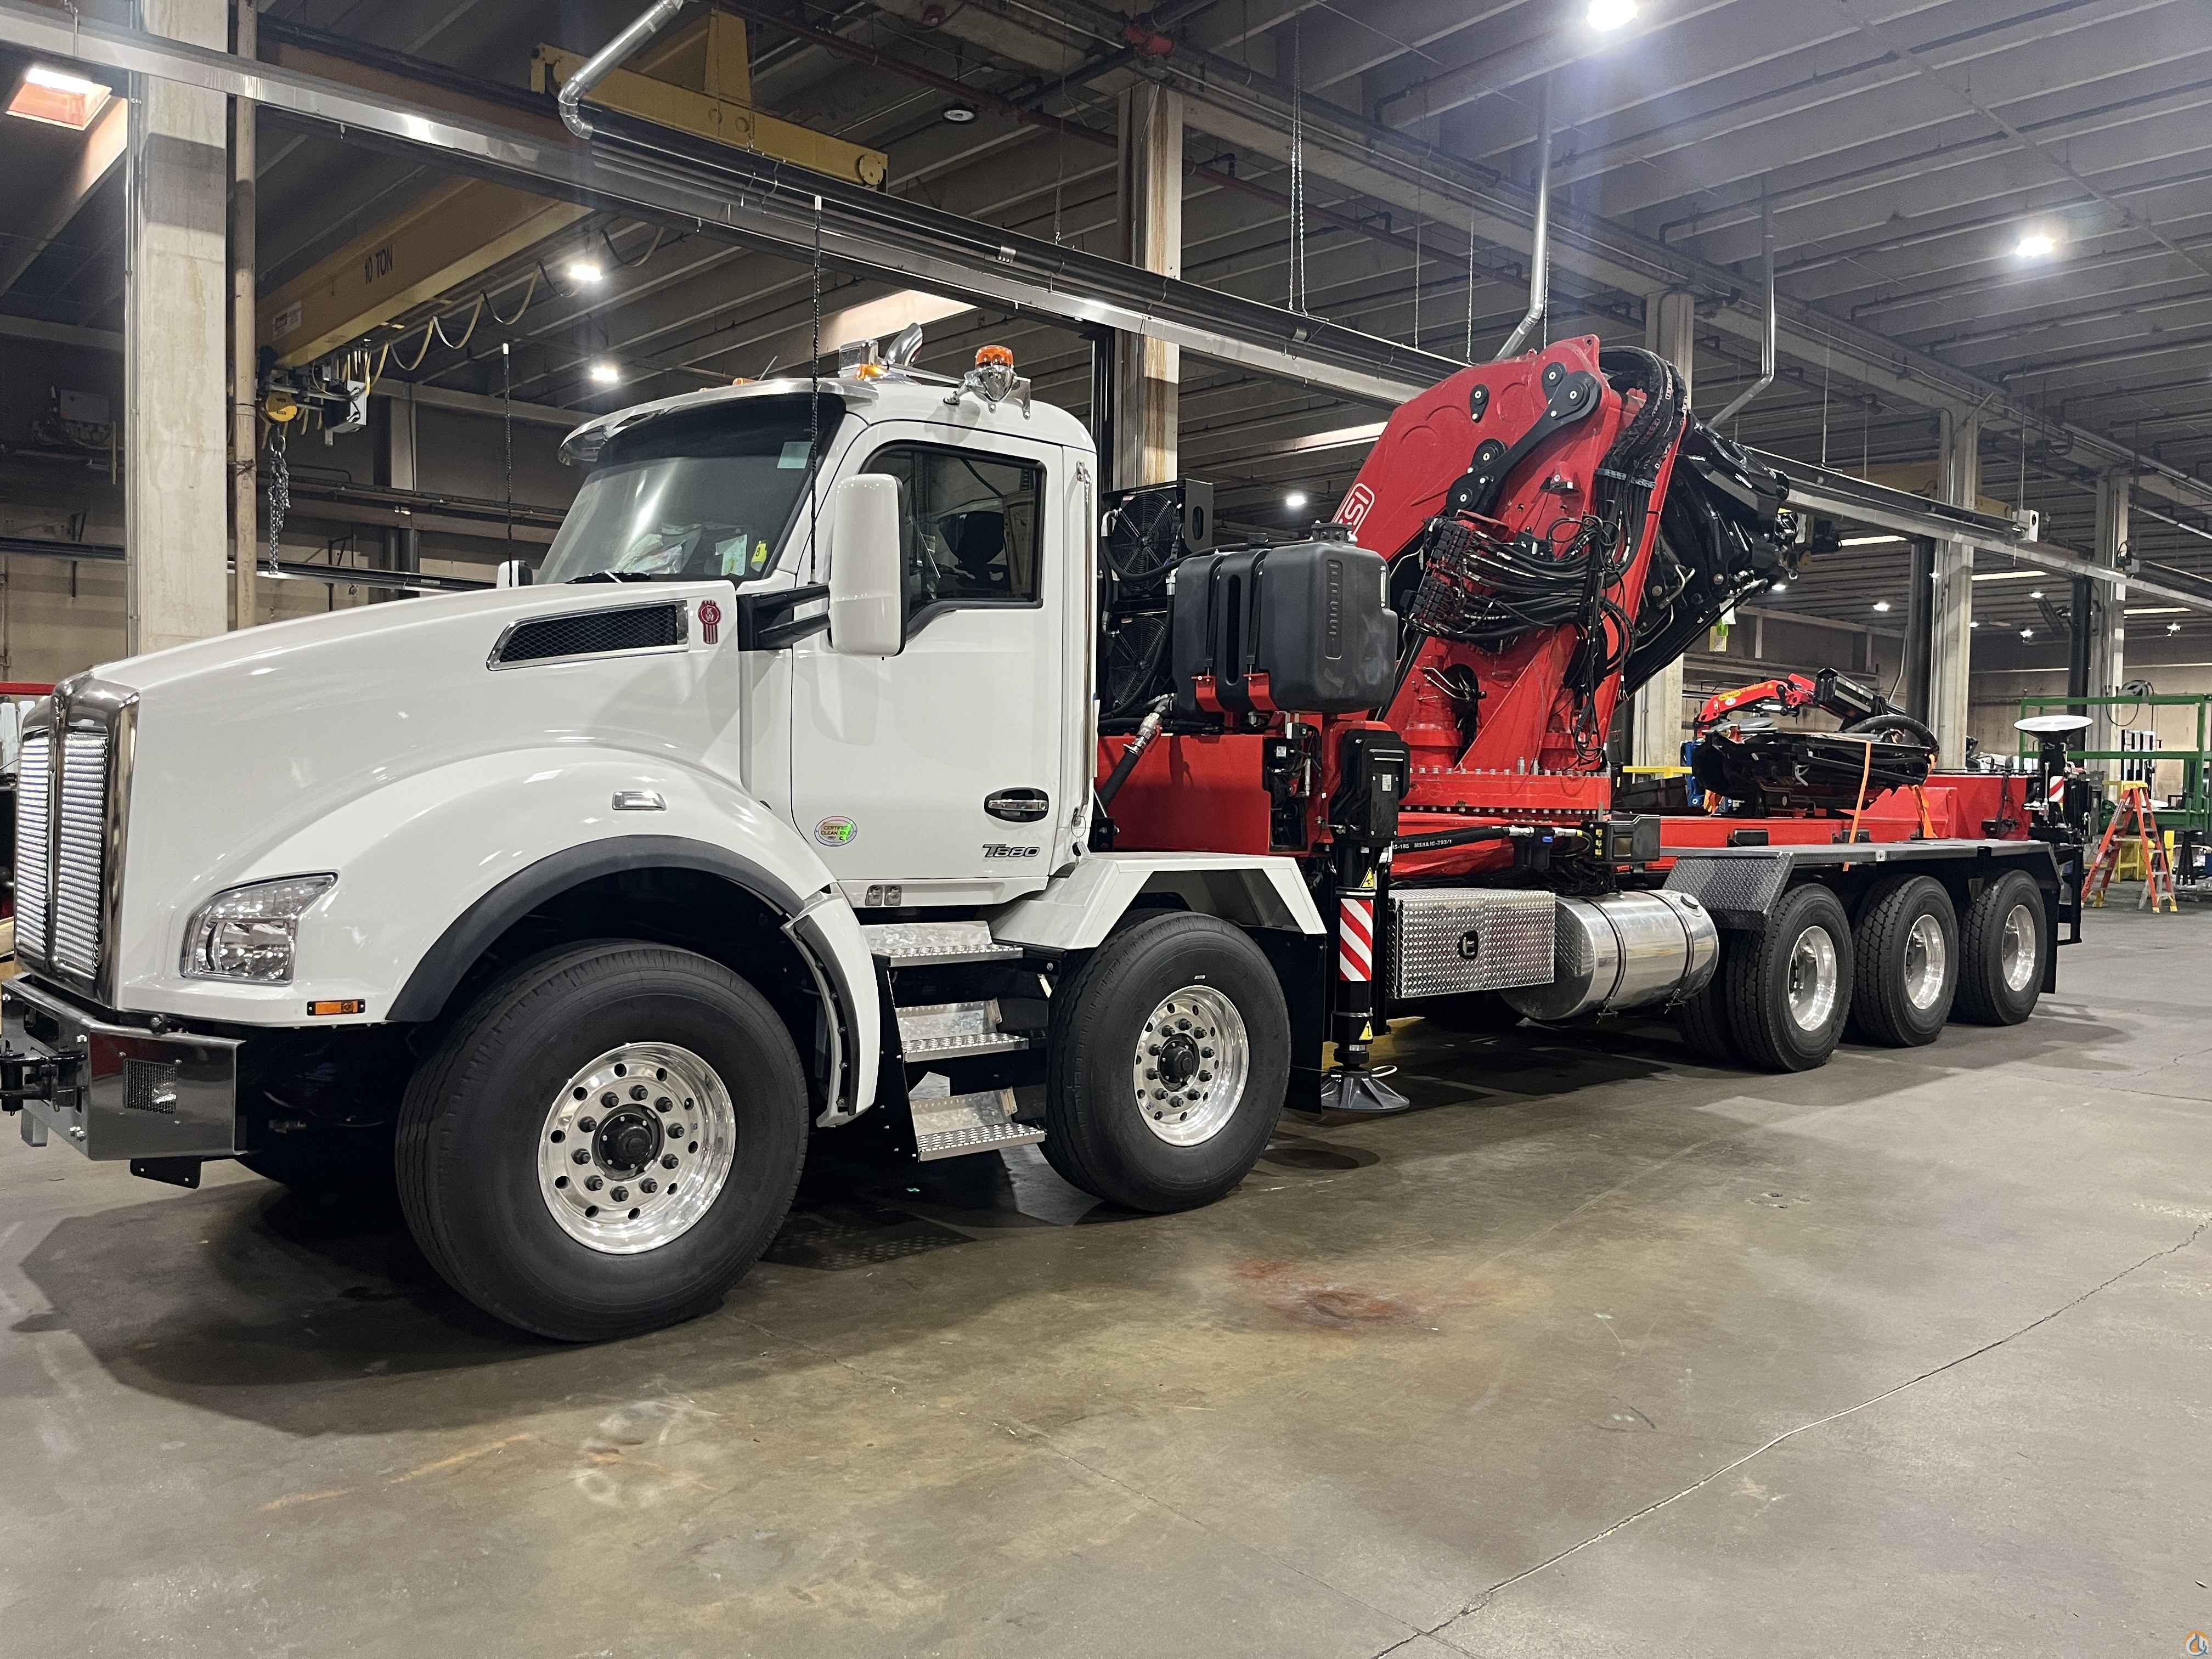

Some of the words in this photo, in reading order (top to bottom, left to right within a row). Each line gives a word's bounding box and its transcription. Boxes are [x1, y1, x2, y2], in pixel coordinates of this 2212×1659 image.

[364, 257, 373, 284] 10
[376, 245, 393, 278] TON
[983, 844, 1040, 857] T880
